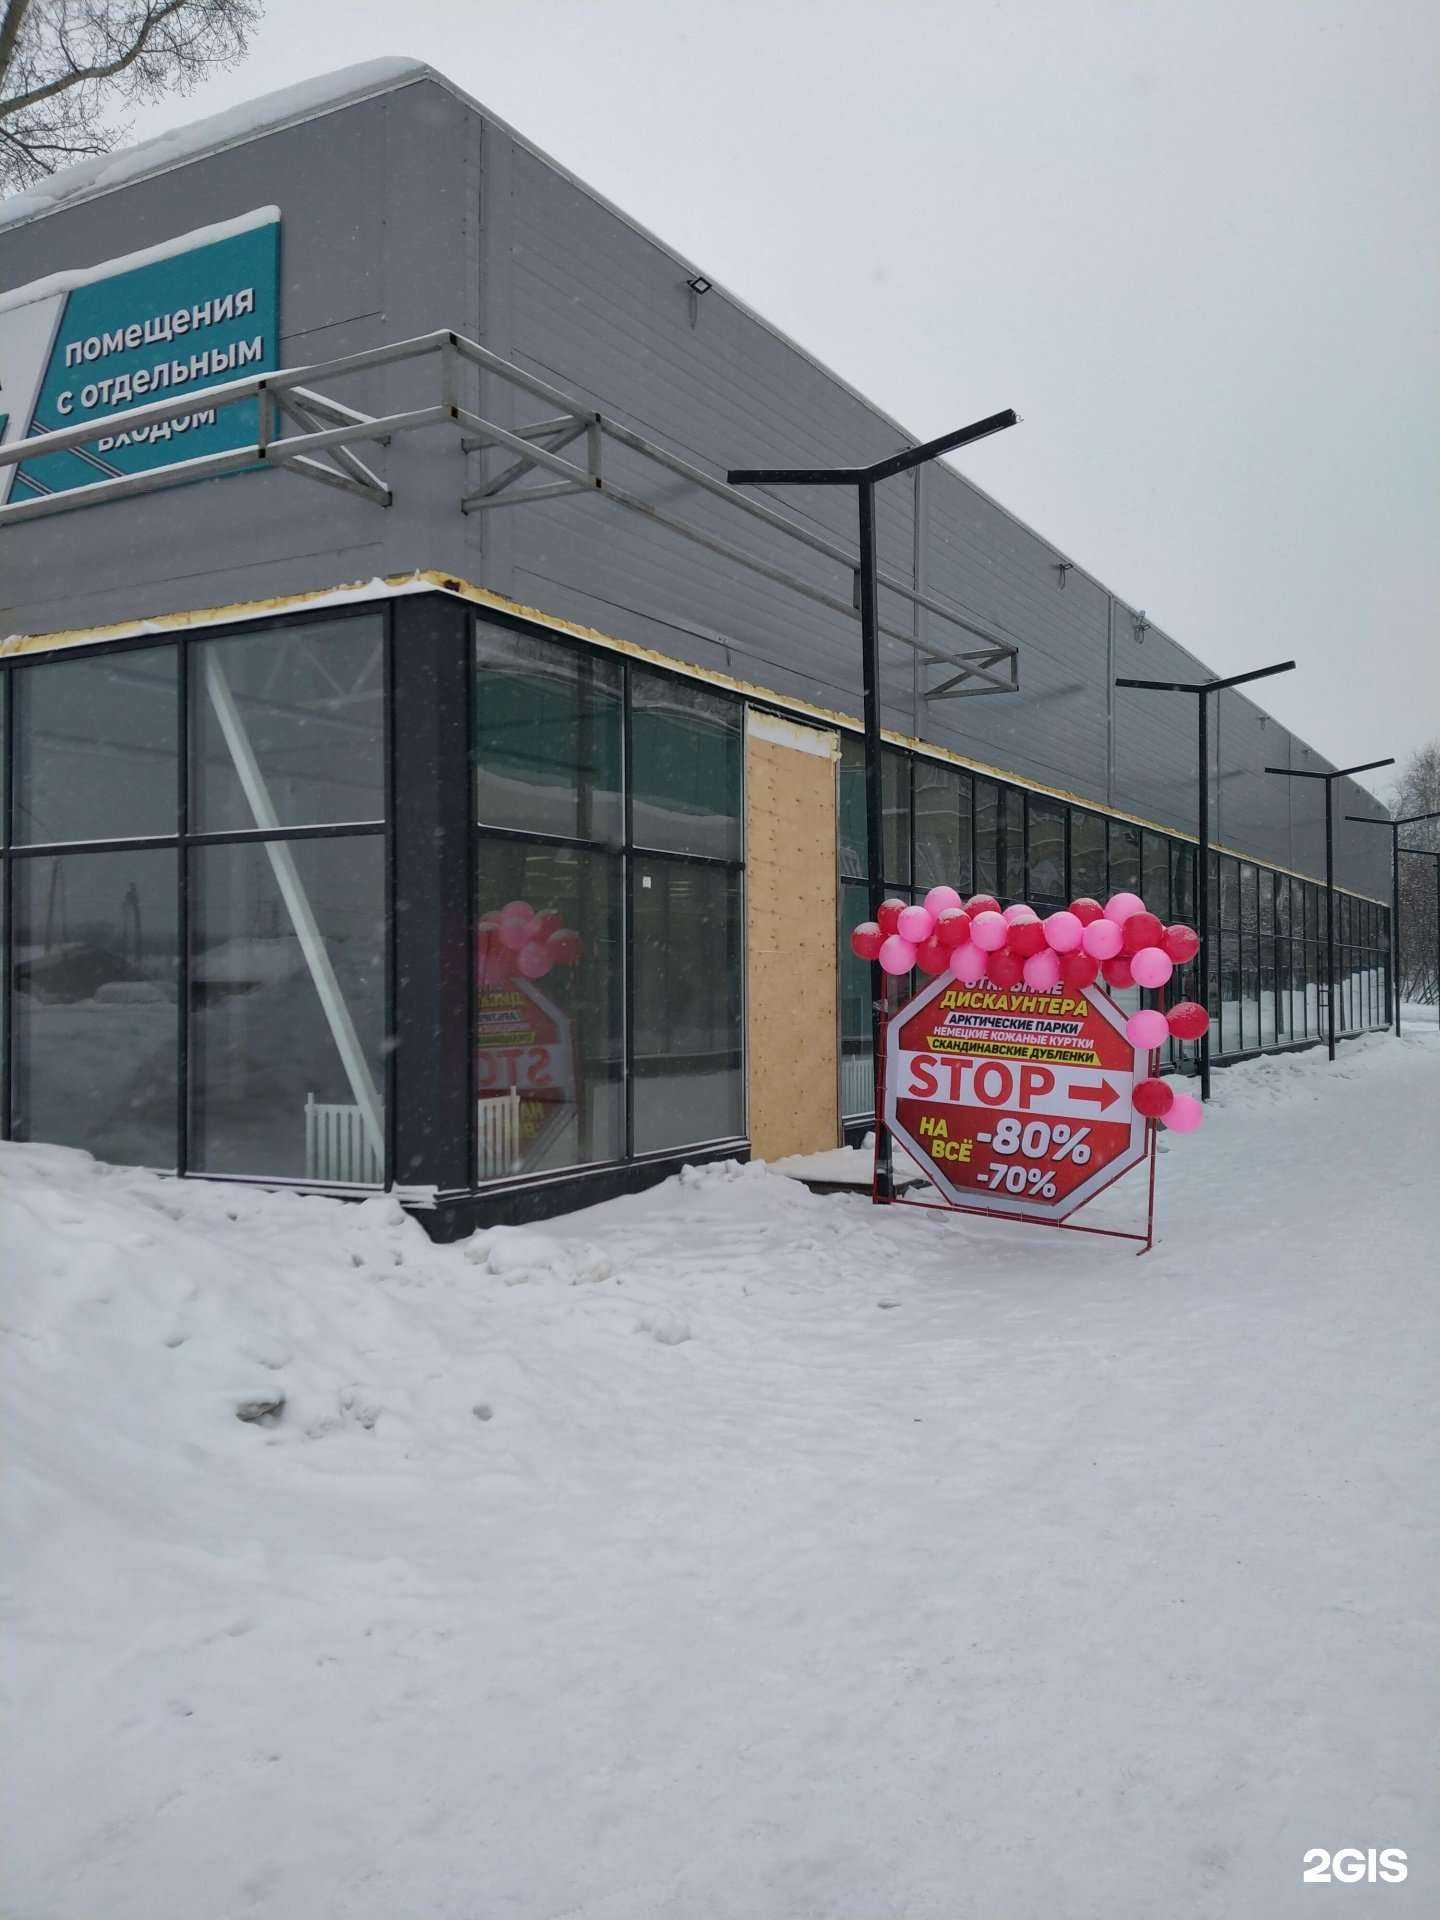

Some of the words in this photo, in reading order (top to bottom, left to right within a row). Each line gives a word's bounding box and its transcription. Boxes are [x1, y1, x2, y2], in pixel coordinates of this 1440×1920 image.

[65, 287, 254, 367] помещения
[80, 335, 264, 409] отдельным
[939, 991, 1089, 1018] ДИСКАУНТЕРА
[933, 1025, 989, 1041] НЕМЕЦКИЕ
[991, 1032, 1048, 1045] КОЖАНЫЕ
[1049, 1036, 1094, 1049] КУРТКИ
[949, 1014, 1032, 1032] АРКТИЧЕСКИЕ
[1035, 1022, 1079, 1035] ПАРКИ
[932, 1039, 1028, 1058] СКАНДИНАВСКИЕ
[1029, 1050, 1095, 1064] ДУБЛЕНКИ
[908, 1054, 1056, 1110] STOP
[919, 1116, 949, 1138] НА
[931, 1139, 973, 1163] ВСЁ
[976, 1117, 1093, 1165] -80%
[976, 1162, 1057, 1198] -70%
